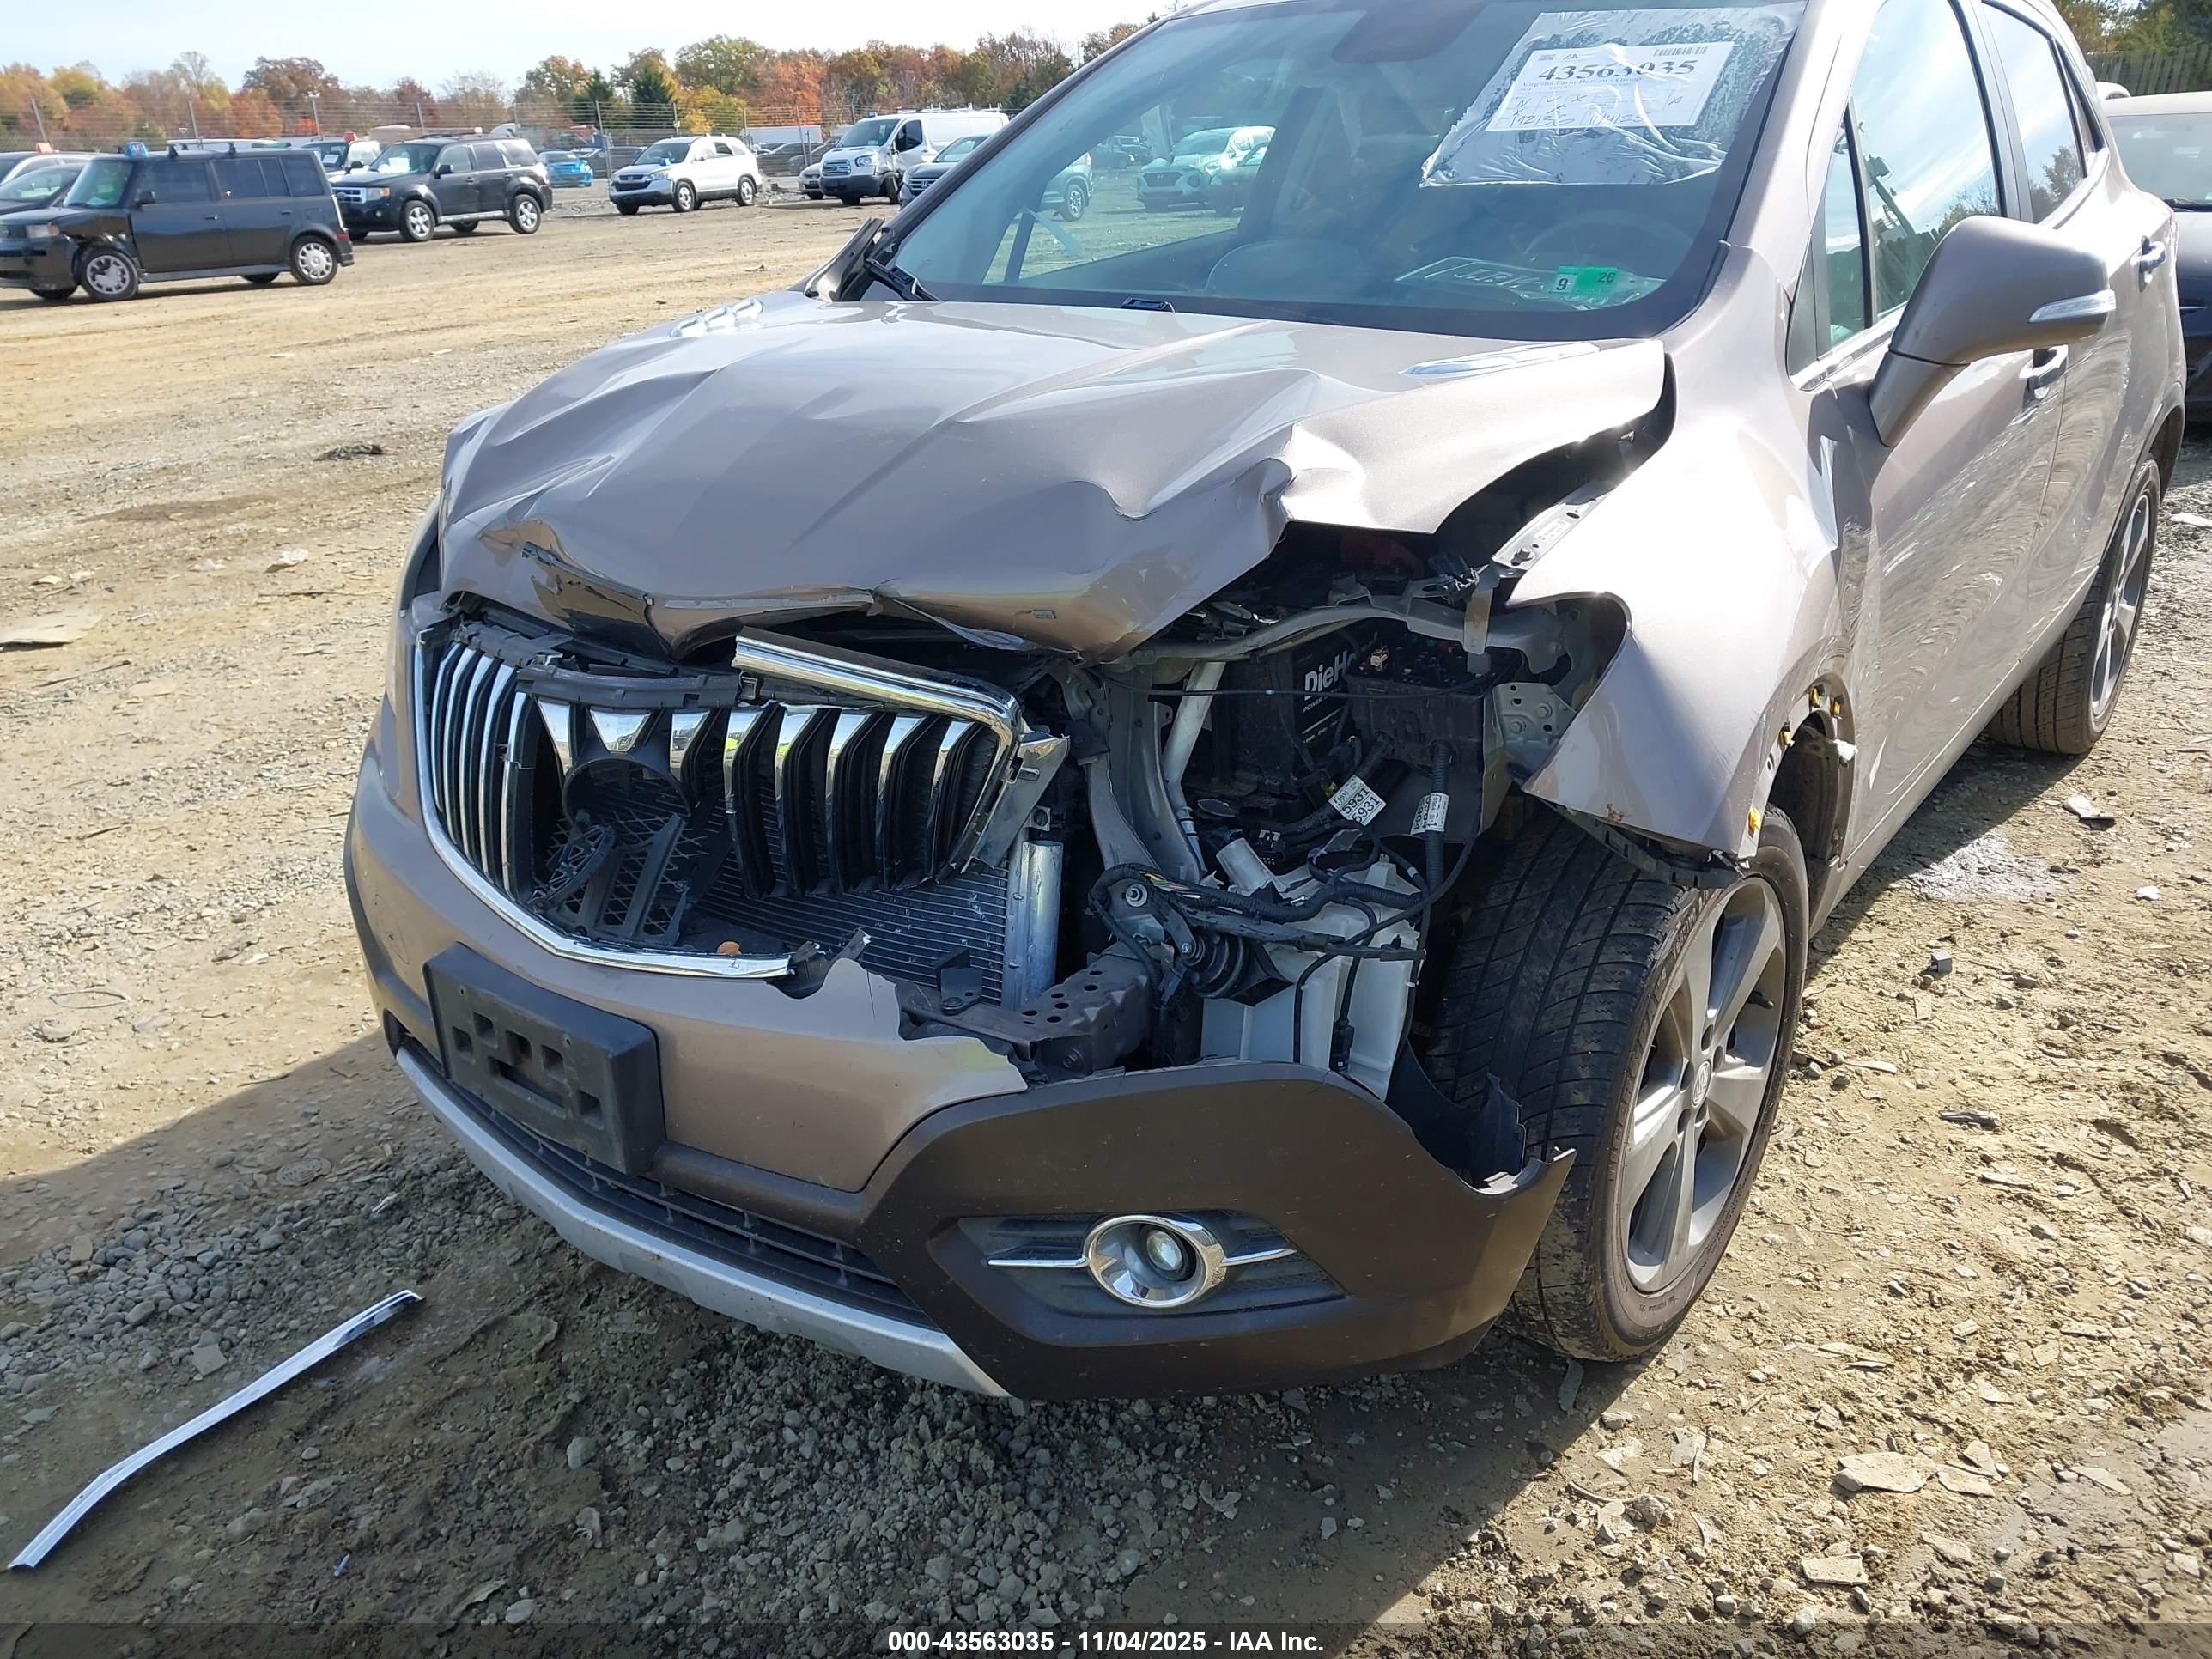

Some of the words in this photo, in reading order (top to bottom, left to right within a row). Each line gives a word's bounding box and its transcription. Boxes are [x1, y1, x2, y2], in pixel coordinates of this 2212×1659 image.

[1556, 277, 1568, 290] 9
[1342, 787, 1370, 814] 5931
[1352, 796, 1381, 823] 5931
